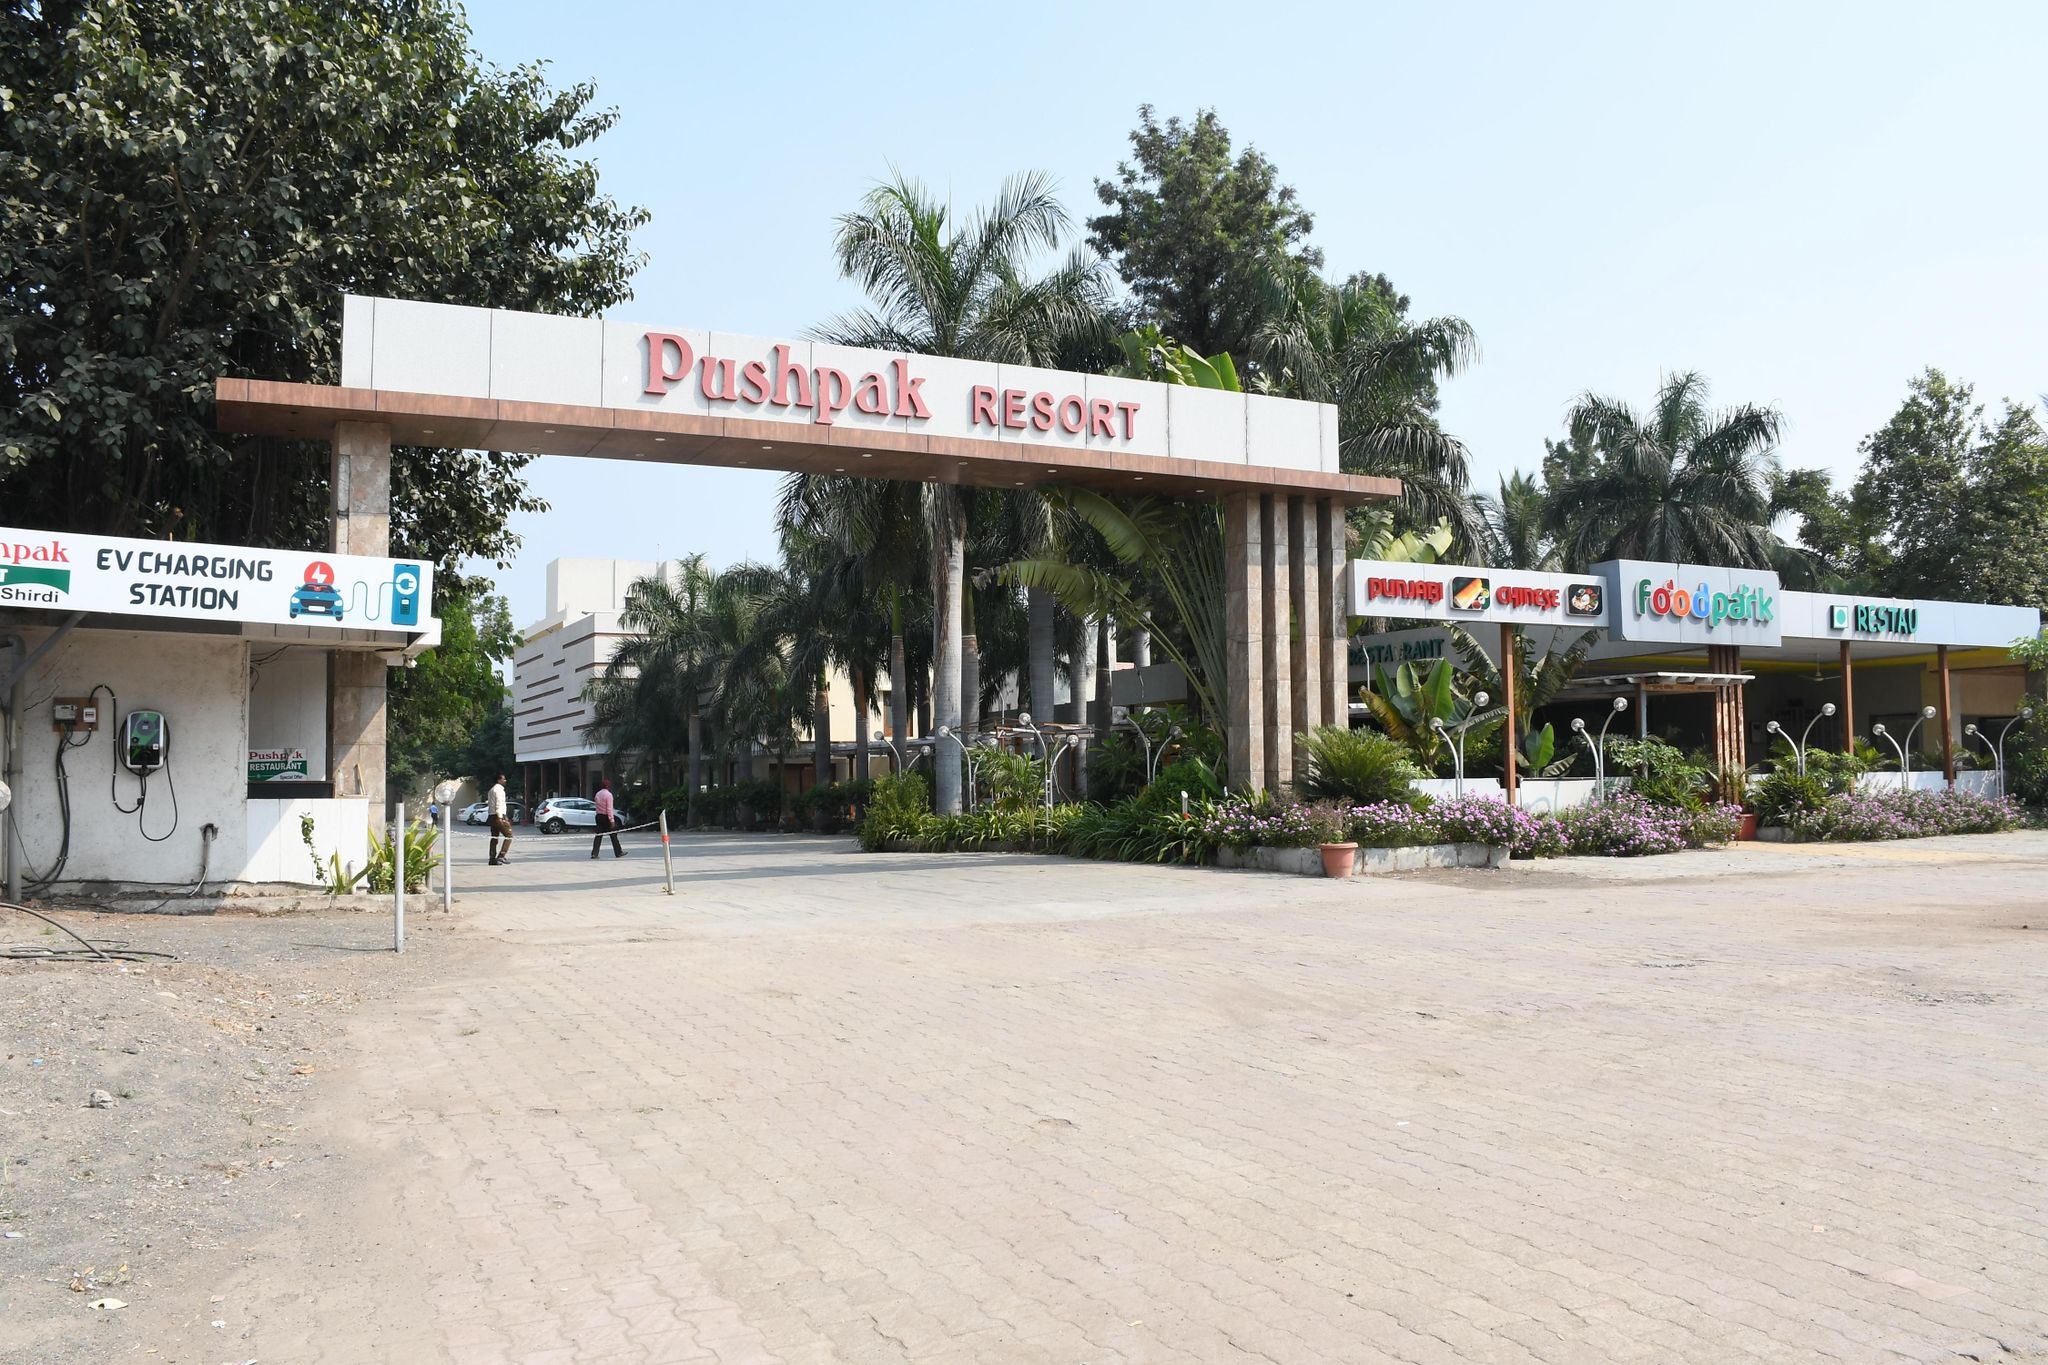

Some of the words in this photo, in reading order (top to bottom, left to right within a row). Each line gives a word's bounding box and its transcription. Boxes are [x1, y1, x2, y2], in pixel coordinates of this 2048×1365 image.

[643, 332, 932, 425] Pushpak
[972, 384, 1141, 440] RESORT
[97, 548, 133, 571] EV
[138, 551, 273, 581] CHARGING
[1, 587, 59, 602] Shirdi
[130, 583, 239, 610] STATION
[1368, 577, 1444, 604] PUNJABI
[1496, 586, 1560, 610] CHINESE
[1636, 578, 1774, 628] foodpark
[1855, 604, 1919, 634] RESTAU
[1349, 639, 1445, 666] RESTARANT
[249, 751, 303, 760] Pushpk
[250, 762, 302, 771] RESTAURANT
